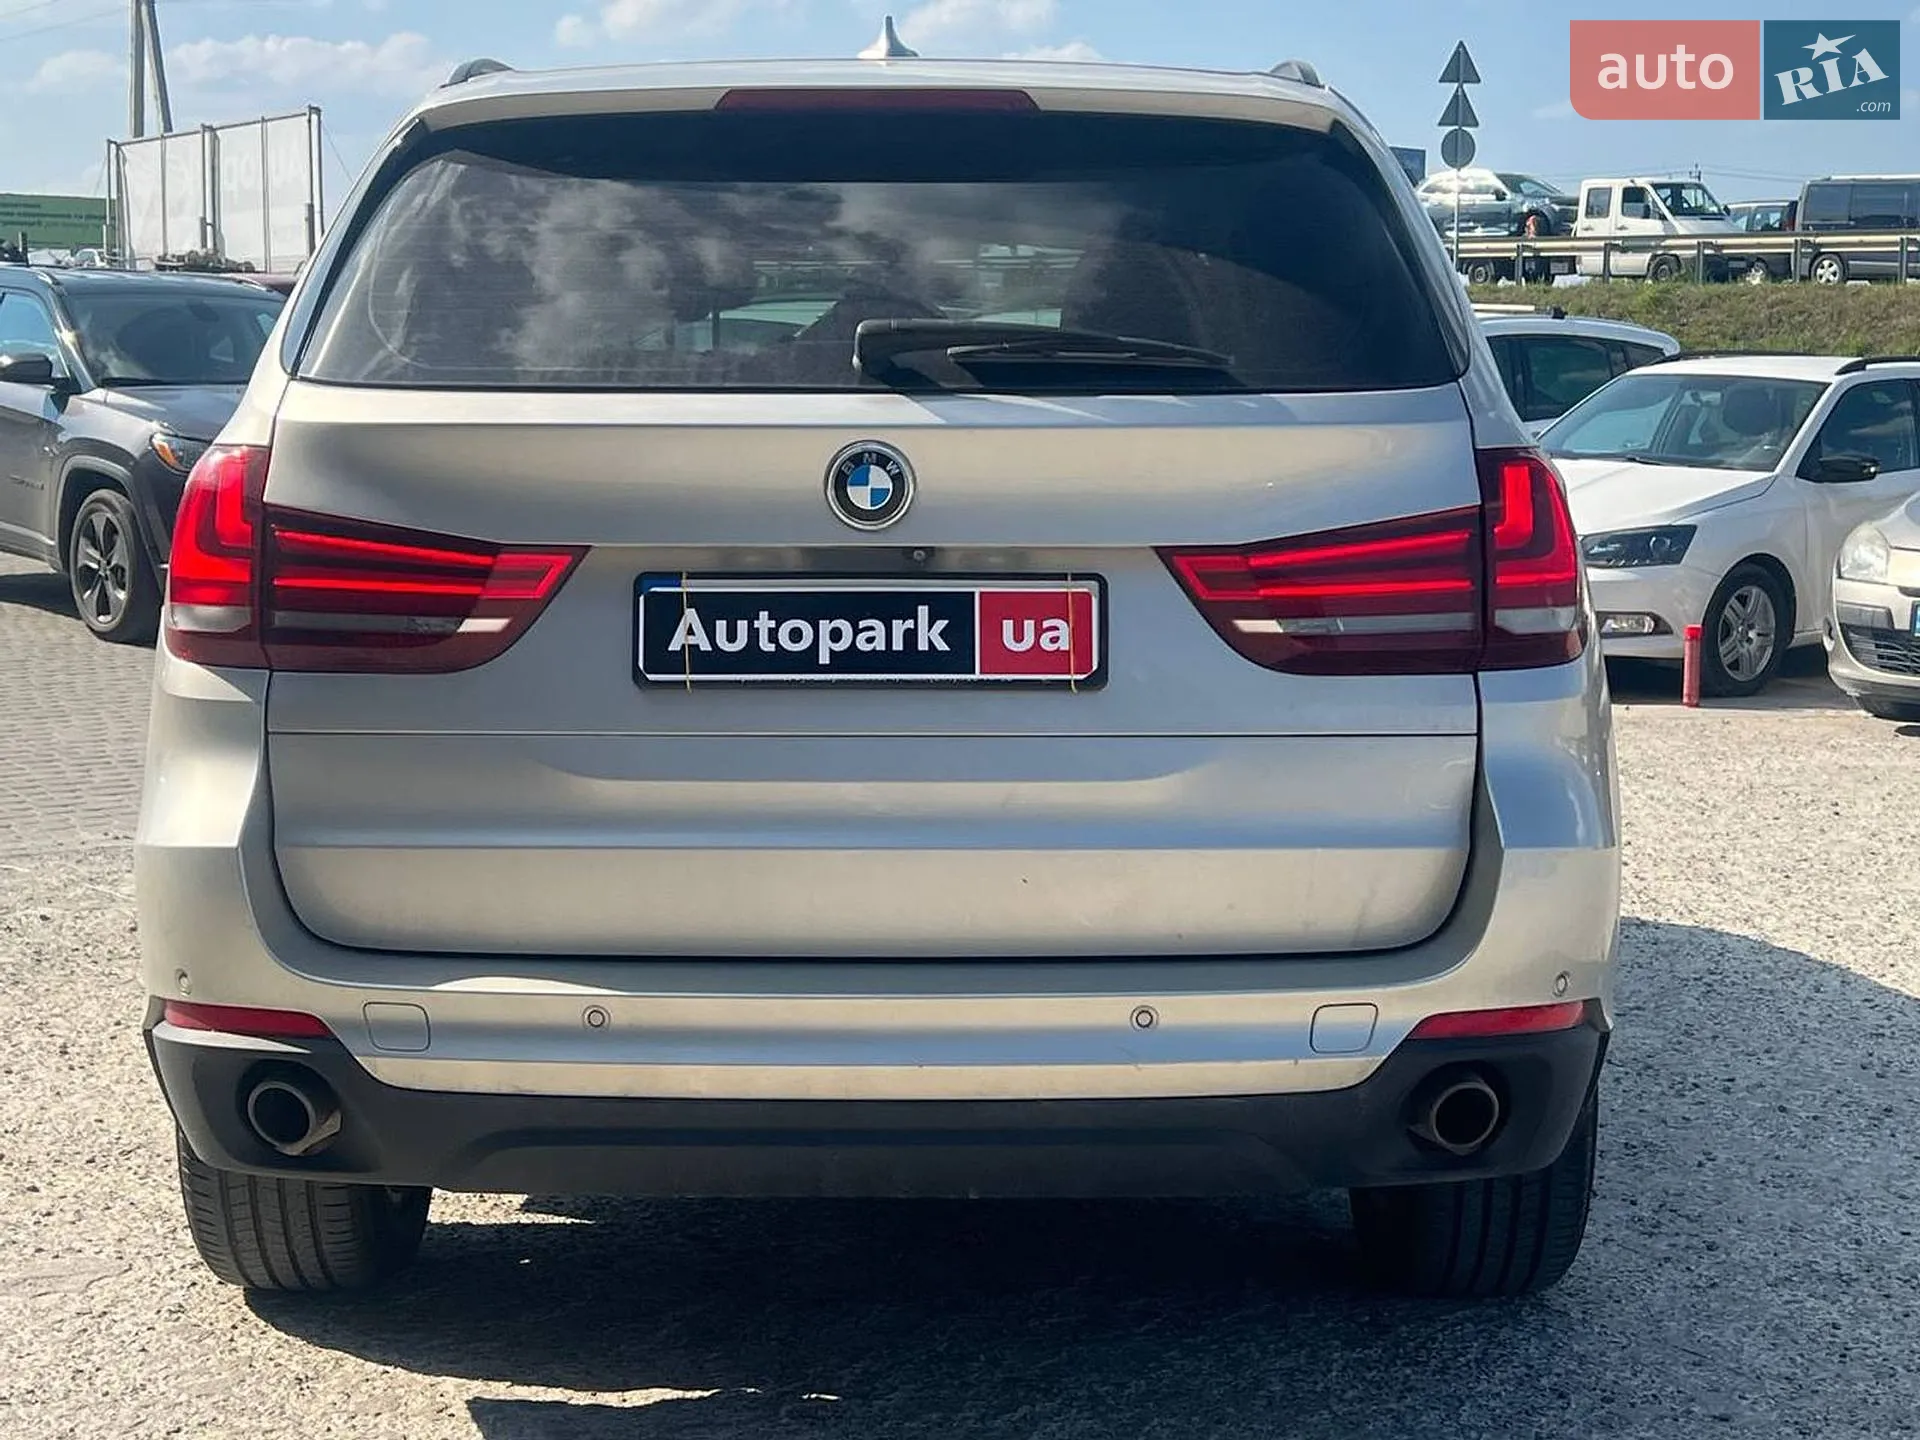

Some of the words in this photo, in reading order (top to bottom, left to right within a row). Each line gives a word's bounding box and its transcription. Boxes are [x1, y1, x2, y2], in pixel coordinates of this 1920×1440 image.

[841, 452, 900, 476] BMW
[667, 604, 951, 665] Autopark
[1001, 616, 1071, 652] ua
